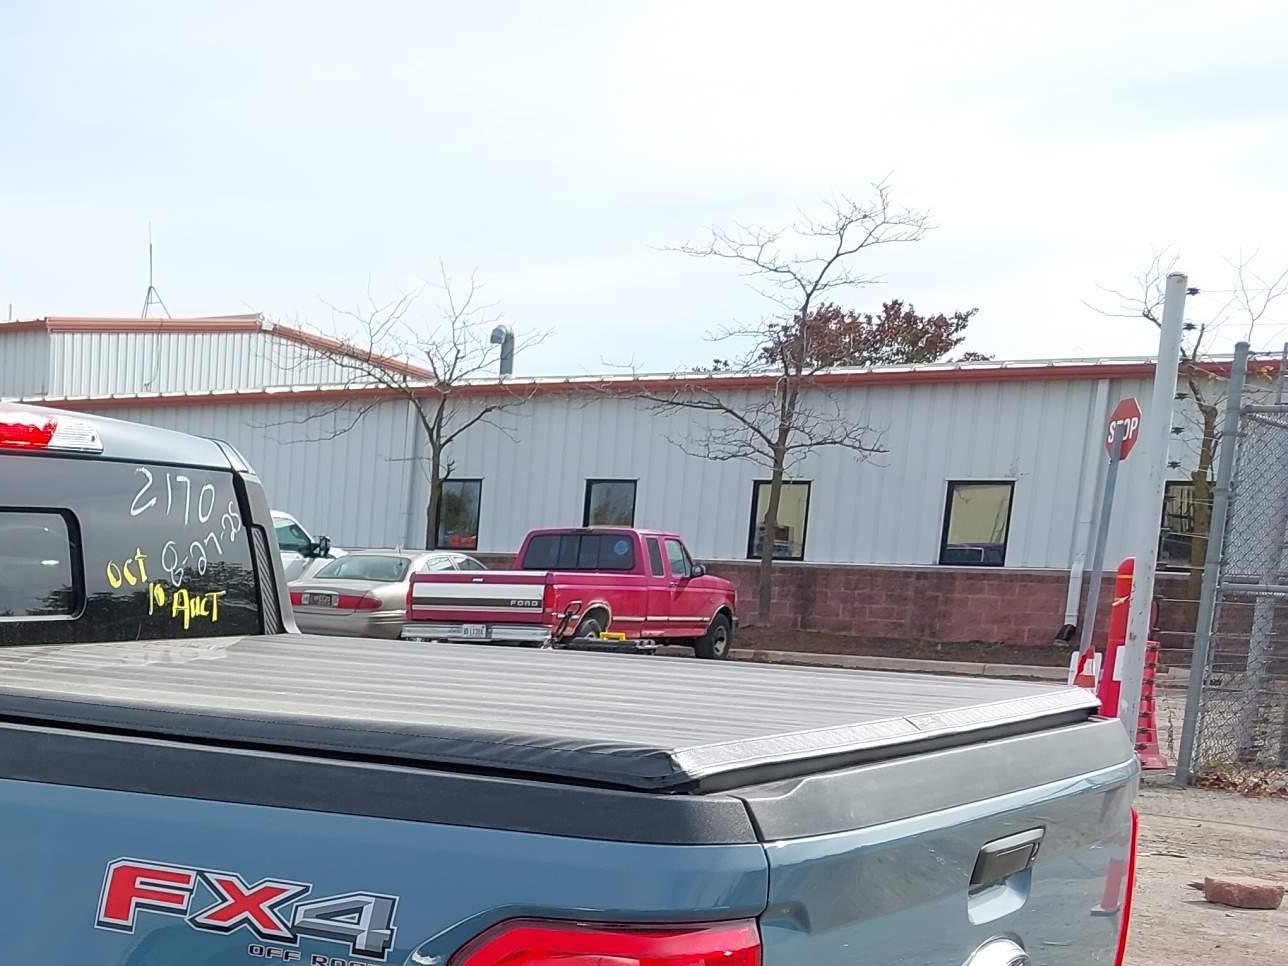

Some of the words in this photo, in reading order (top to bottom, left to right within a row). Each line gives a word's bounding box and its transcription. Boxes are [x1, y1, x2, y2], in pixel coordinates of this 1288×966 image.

[130, 467, 215, 525] 2170
[95, 857, 399, 961] FX4
[247, 943, 301, 961] OFF
